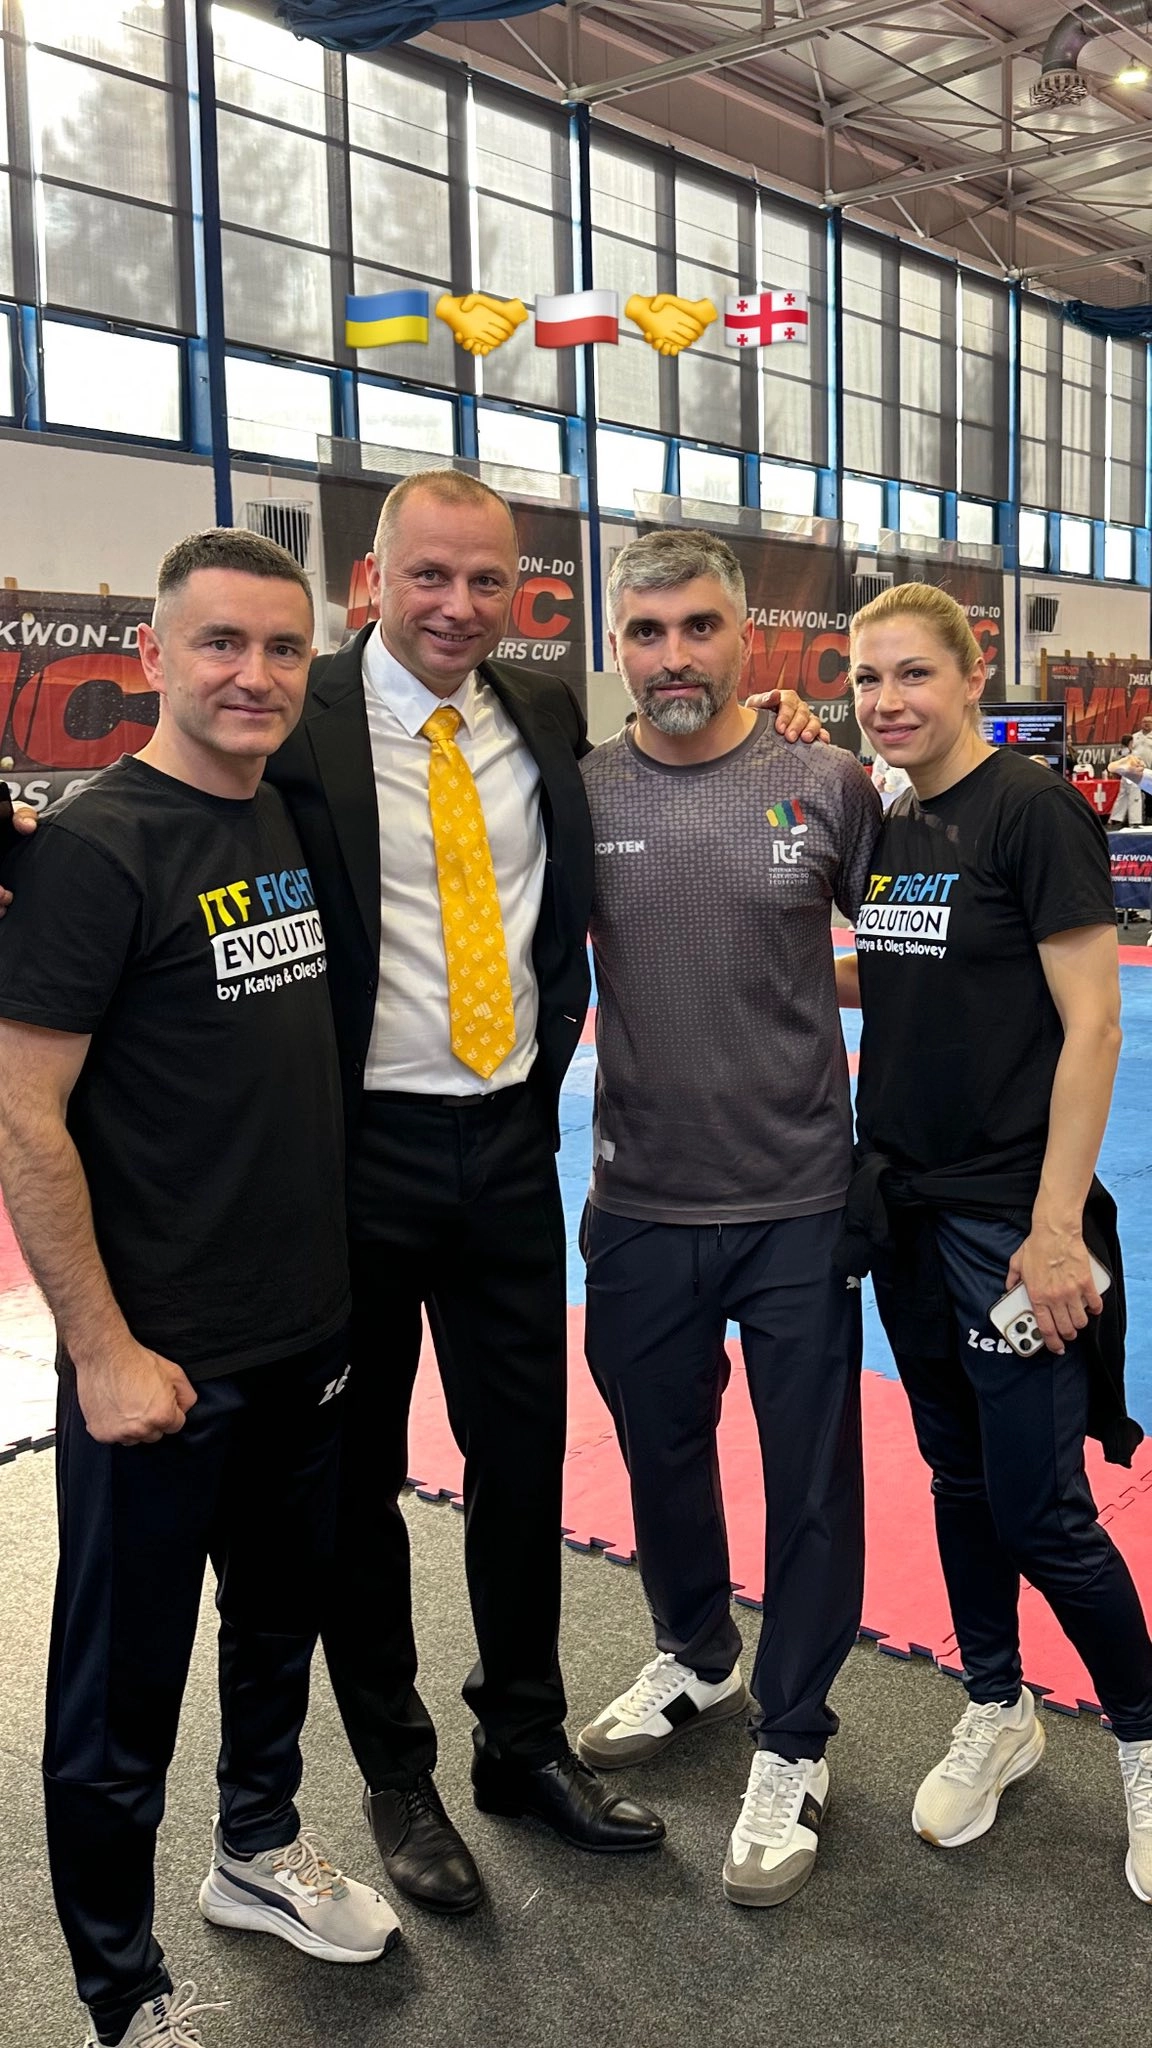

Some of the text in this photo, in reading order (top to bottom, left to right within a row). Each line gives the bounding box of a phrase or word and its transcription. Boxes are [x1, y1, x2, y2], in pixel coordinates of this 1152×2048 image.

[748, 607, 852, 630] TAEKWON-D
[488, 642, 567, 661] ERS CUP
[616, 840, 645, 853] TEN
[888, 872, 960, 903] FIGHT
[198, 880, 251, 936] ITF
[876, 938, 884, 951] &
[884, 939, 905, 956] Oleg
[905, 941, 947, 959] Solovey
[216, 984, 241, 1002] by
[244, 976, 284, 995] Katya
[283, 968, 293, 984] &
[292, 957, 317, 980] Oleg
